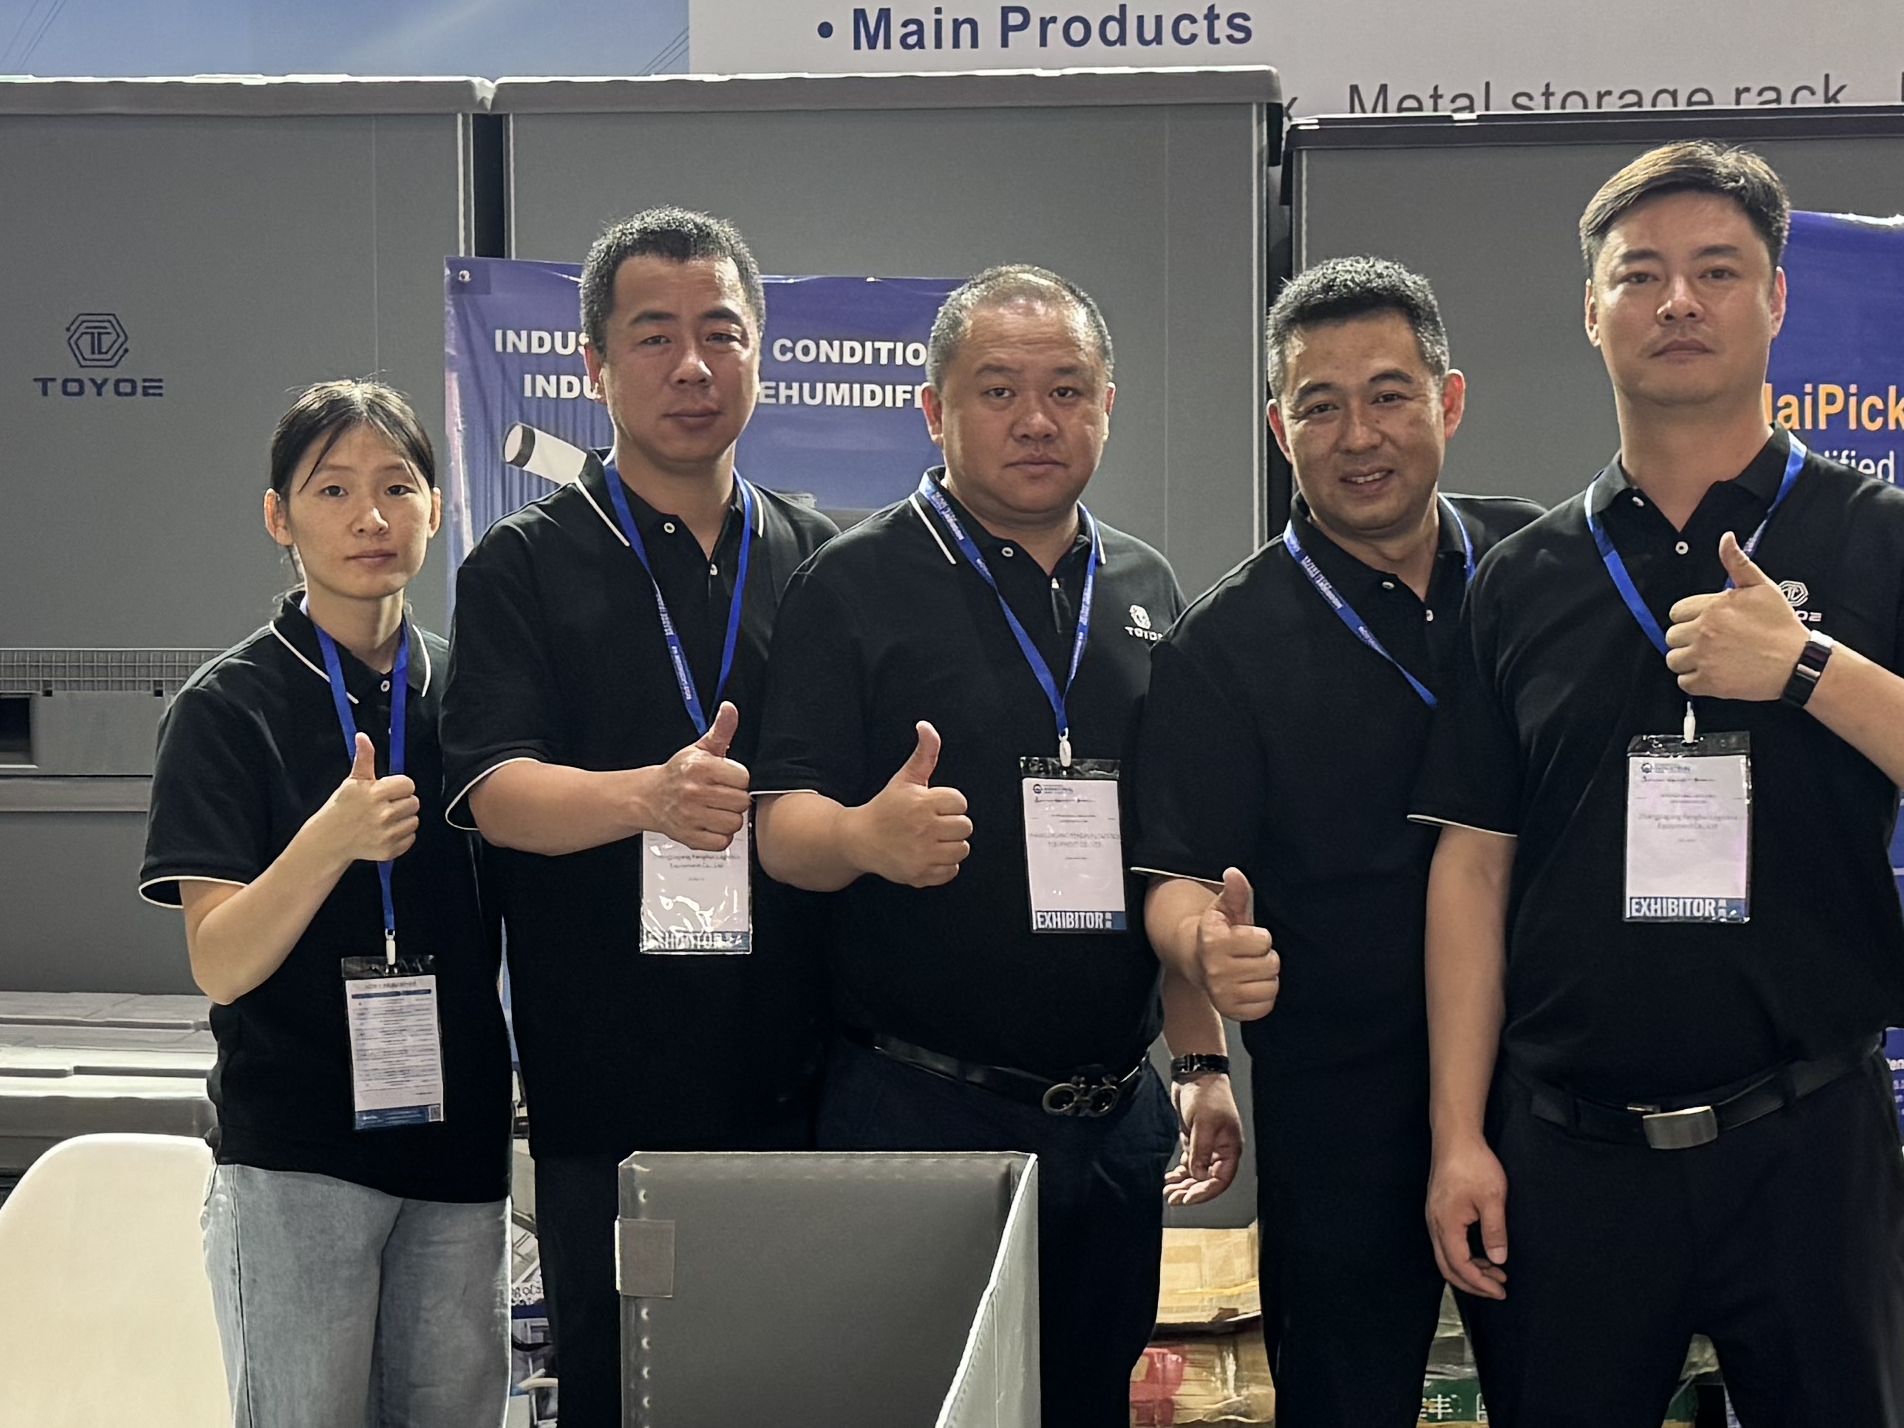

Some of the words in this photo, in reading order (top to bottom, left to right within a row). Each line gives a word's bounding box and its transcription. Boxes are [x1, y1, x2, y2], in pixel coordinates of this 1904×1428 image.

[852, 6, 980, 50] Main
[1000, 2, 1254, 48] Products
[1348, 80, 1491, 114] Metal
[1734, 72, 1848, 106] rack
[772, 338, 928, 366] CONDITIO
[33, 376, 165, 399] TOYOE
[1630, 897, 1717, 918] EXHIBITOR
[1036, 911, 1104, 930] EXHIBITOR
